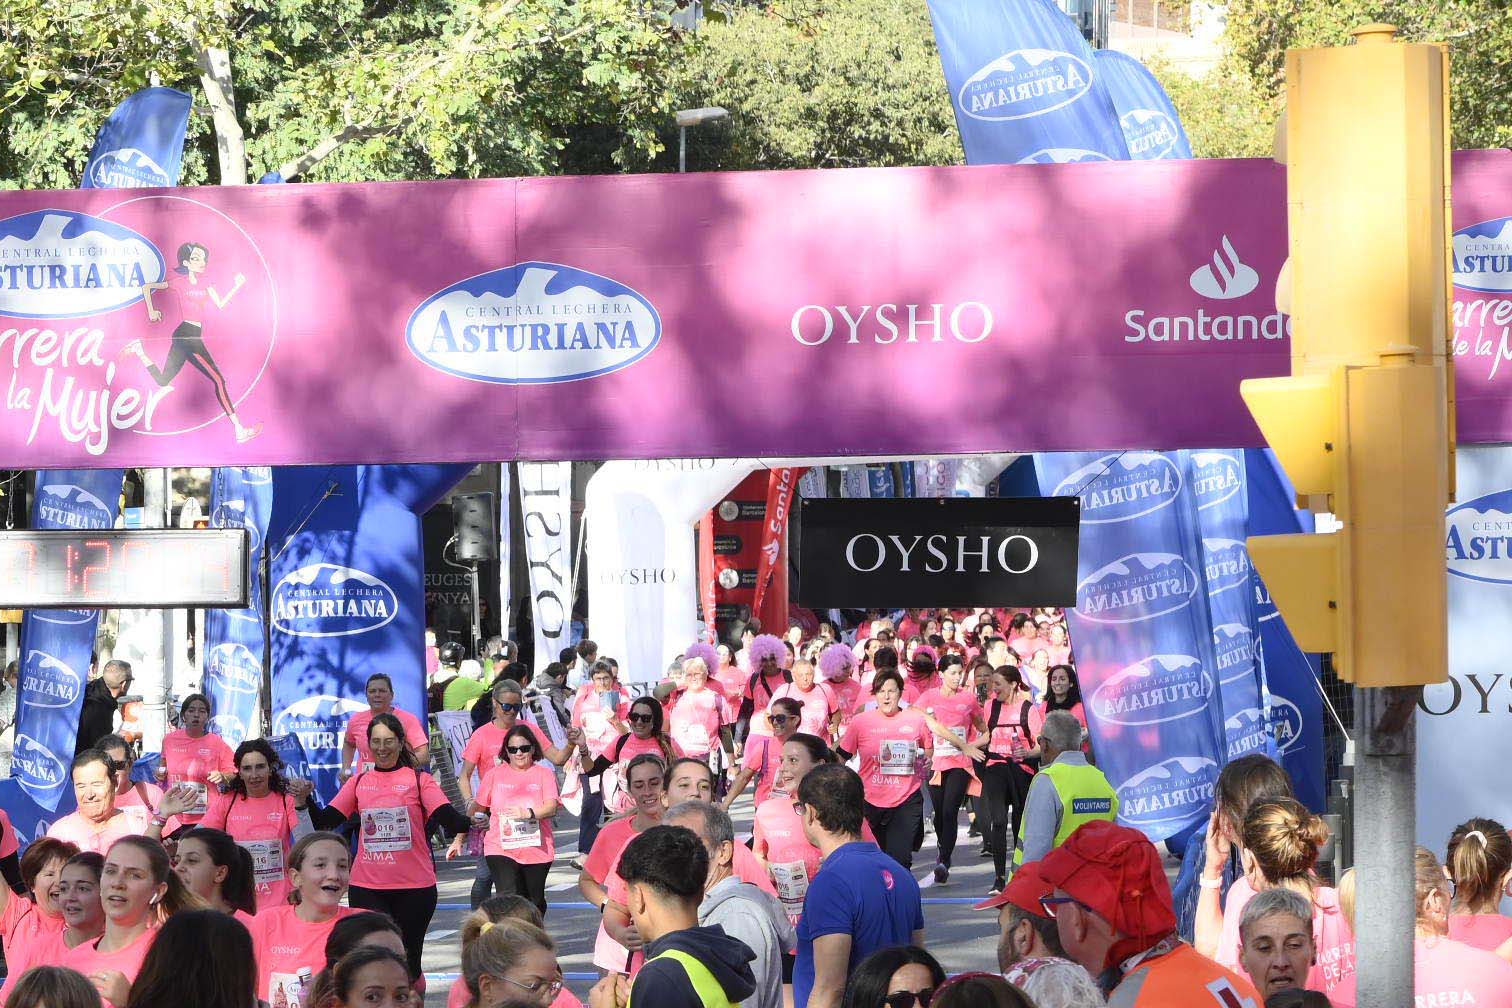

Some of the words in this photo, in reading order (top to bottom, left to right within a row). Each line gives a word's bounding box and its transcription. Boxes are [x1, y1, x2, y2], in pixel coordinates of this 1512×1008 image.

[67, 245, 142, 258] LECHERA
[1465, 243, 1511, 251] CENTRA
[464, 305, 545, 318] CENTRAL
[551, 302, 634, 316] LECHERA
[426, 307, 641, 353] ASTURIANA
[790, 300, 994, 347] OYSHO
[7, 372, 31, 410] la
[26, 366, 176, 456] Mujer
[769, 467, 792, 535] Santa
[40, 505, 107, 529] STURIANA
[845, 533, 1040, 574] OYSHO
[275, 592, 389, 620] ASTURIANA
[288, 589, 330, 598] CENTRAL
[334, 588, 384, 597] LECHERA
[871, 774, 900, 785] SUMA
